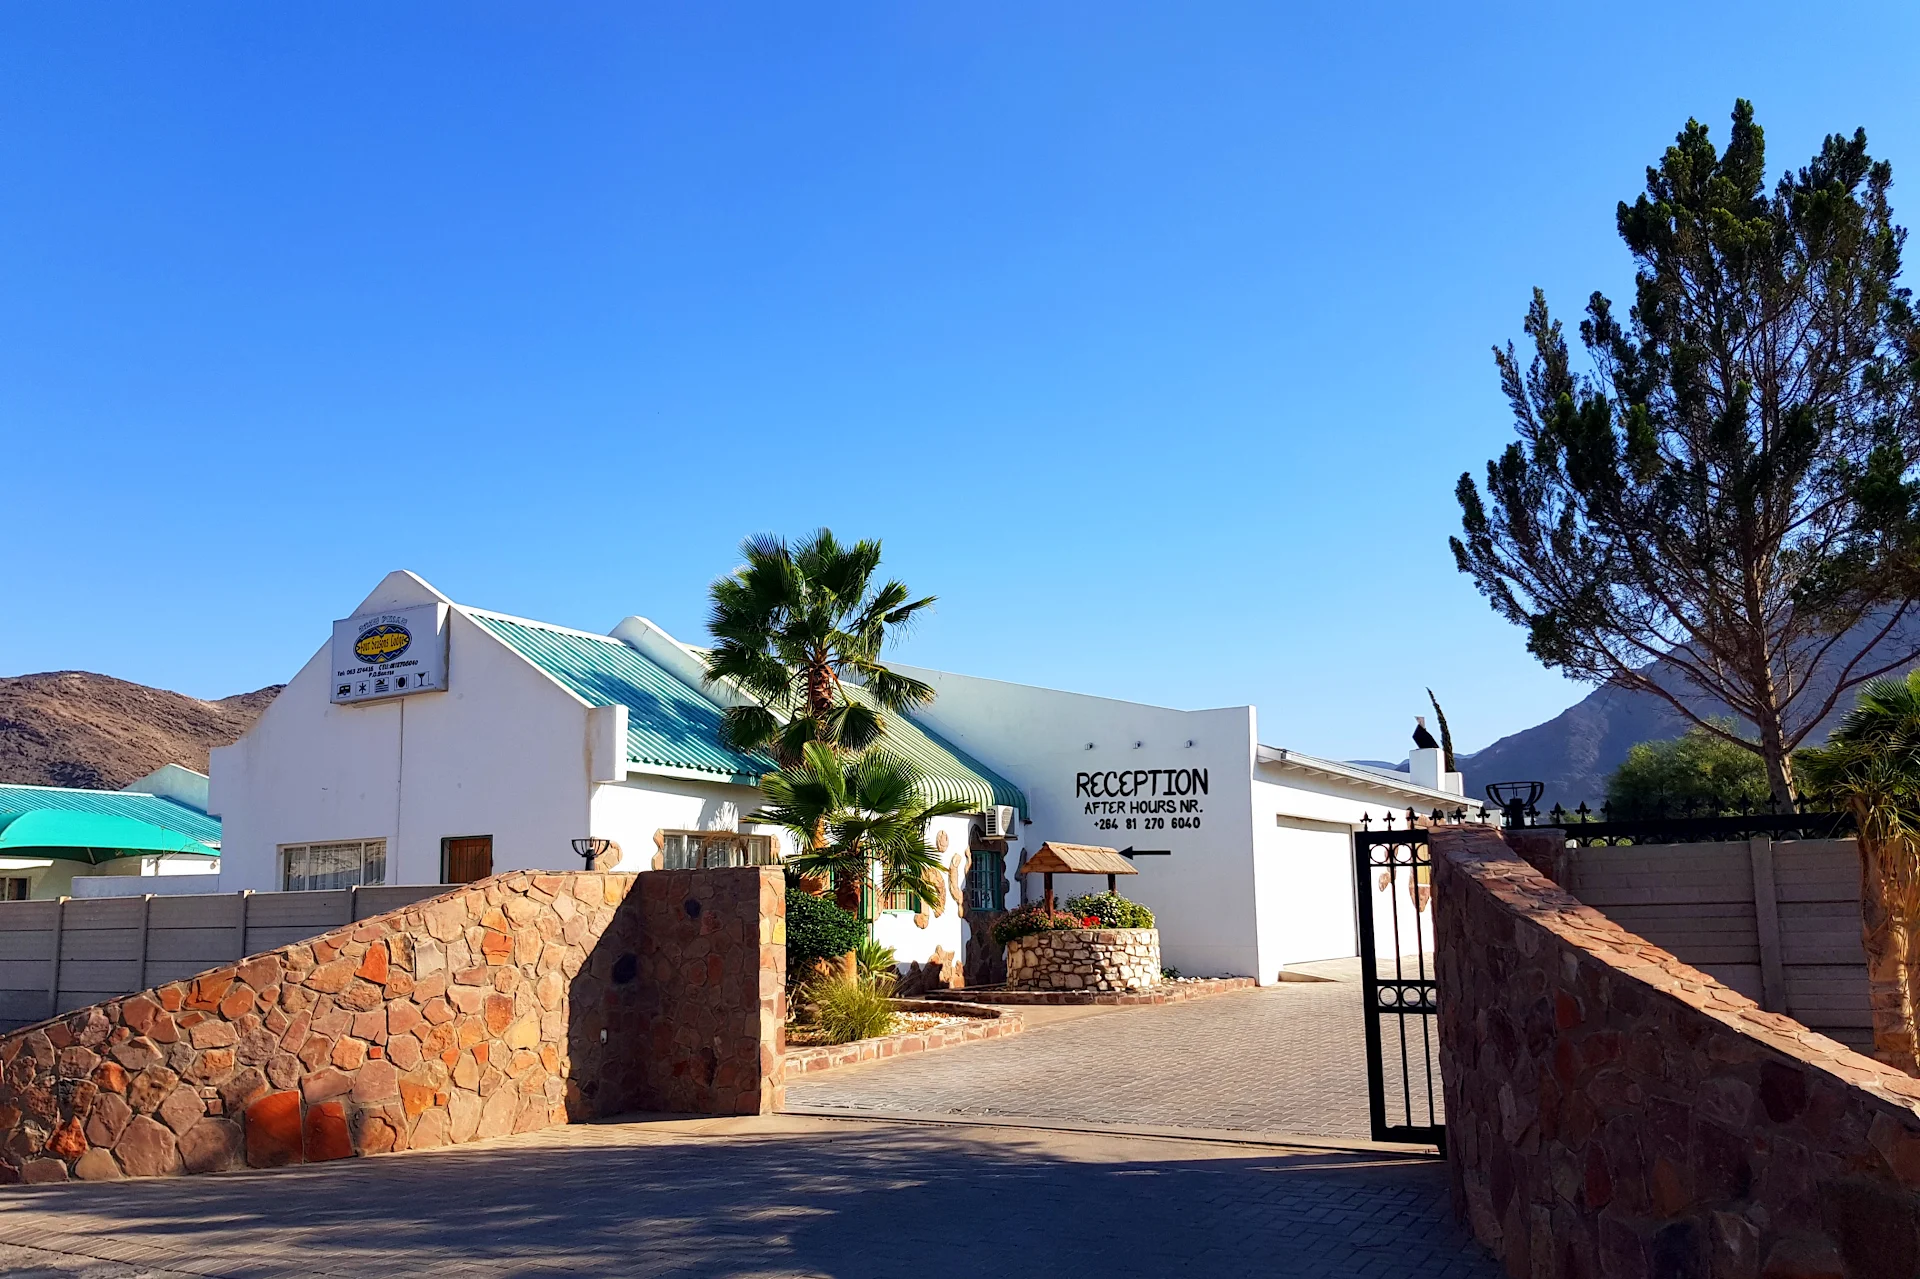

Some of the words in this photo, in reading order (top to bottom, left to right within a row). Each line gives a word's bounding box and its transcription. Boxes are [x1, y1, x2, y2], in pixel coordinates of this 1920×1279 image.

[390, 633, 405, 648] Lodge
[1076, 768, 1209, 798] RECEPTION
[1084, 801, 1126, 815] AFTER
[1130, 800, 1177, 814] HOURS
[1180, 799, 1204, 813] NR.
[1094, 818, 1119, 830] +264
[1126, 818, 1137, 830] 81
[1144, 817, 1165, 830] 270
[1171, 816, 1201, 829] 6040
